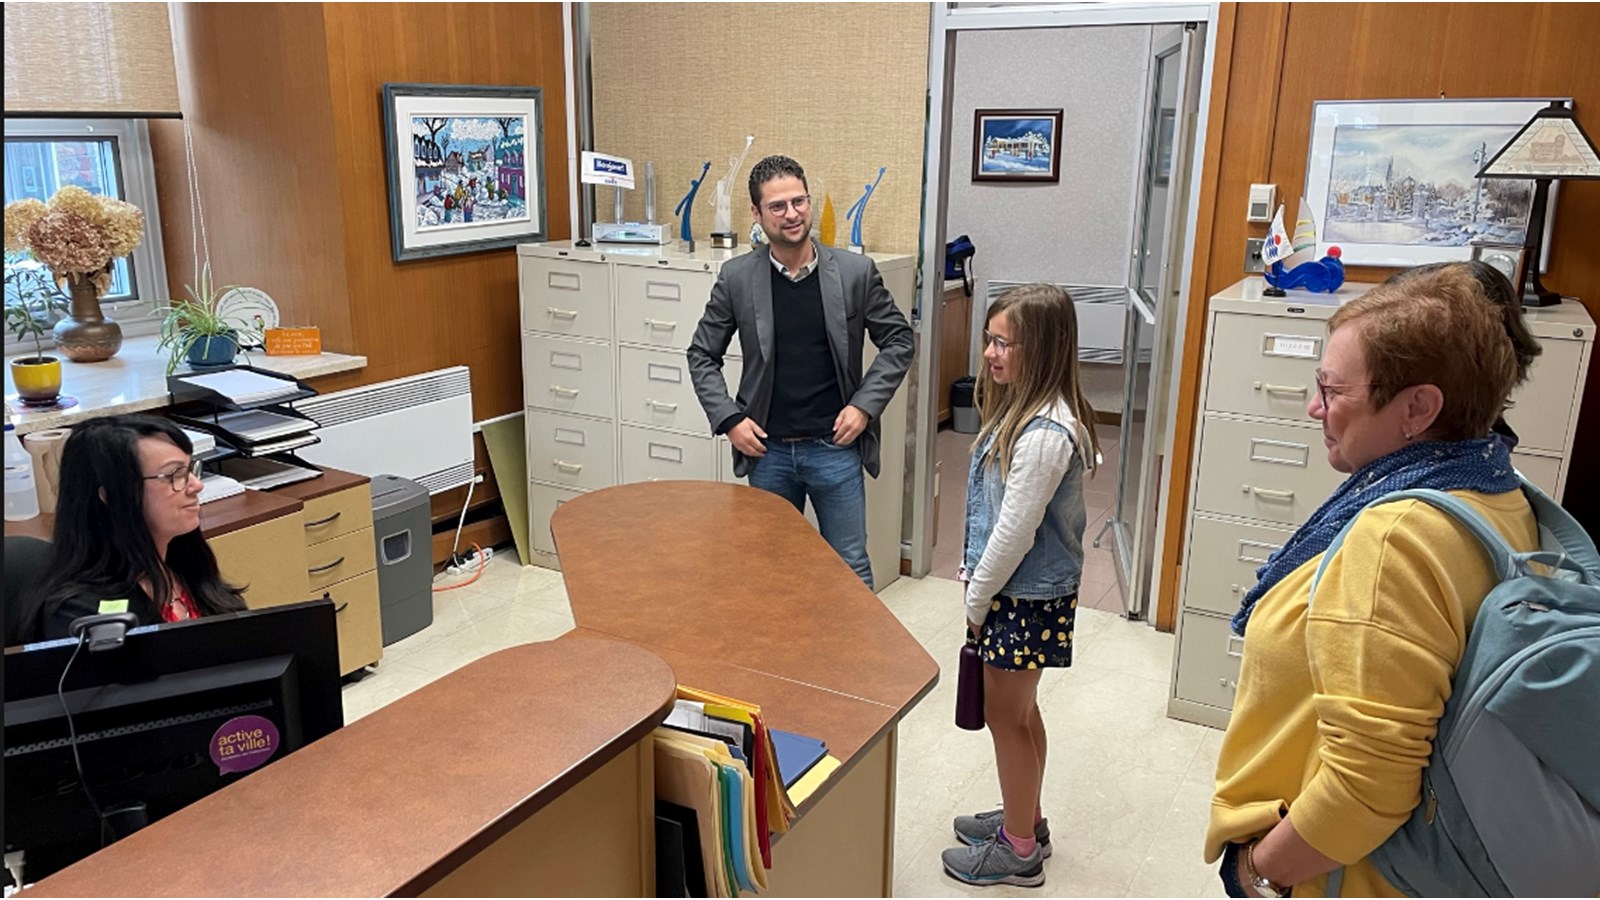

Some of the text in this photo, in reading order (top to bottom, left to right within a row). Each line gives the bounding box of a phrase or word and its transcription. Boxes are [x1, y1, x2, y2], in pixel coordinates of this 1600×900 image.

[218, 728, 263, 746] active
[219, 745, 235, 756] ta
[237, 734, 271, 752] ville!
